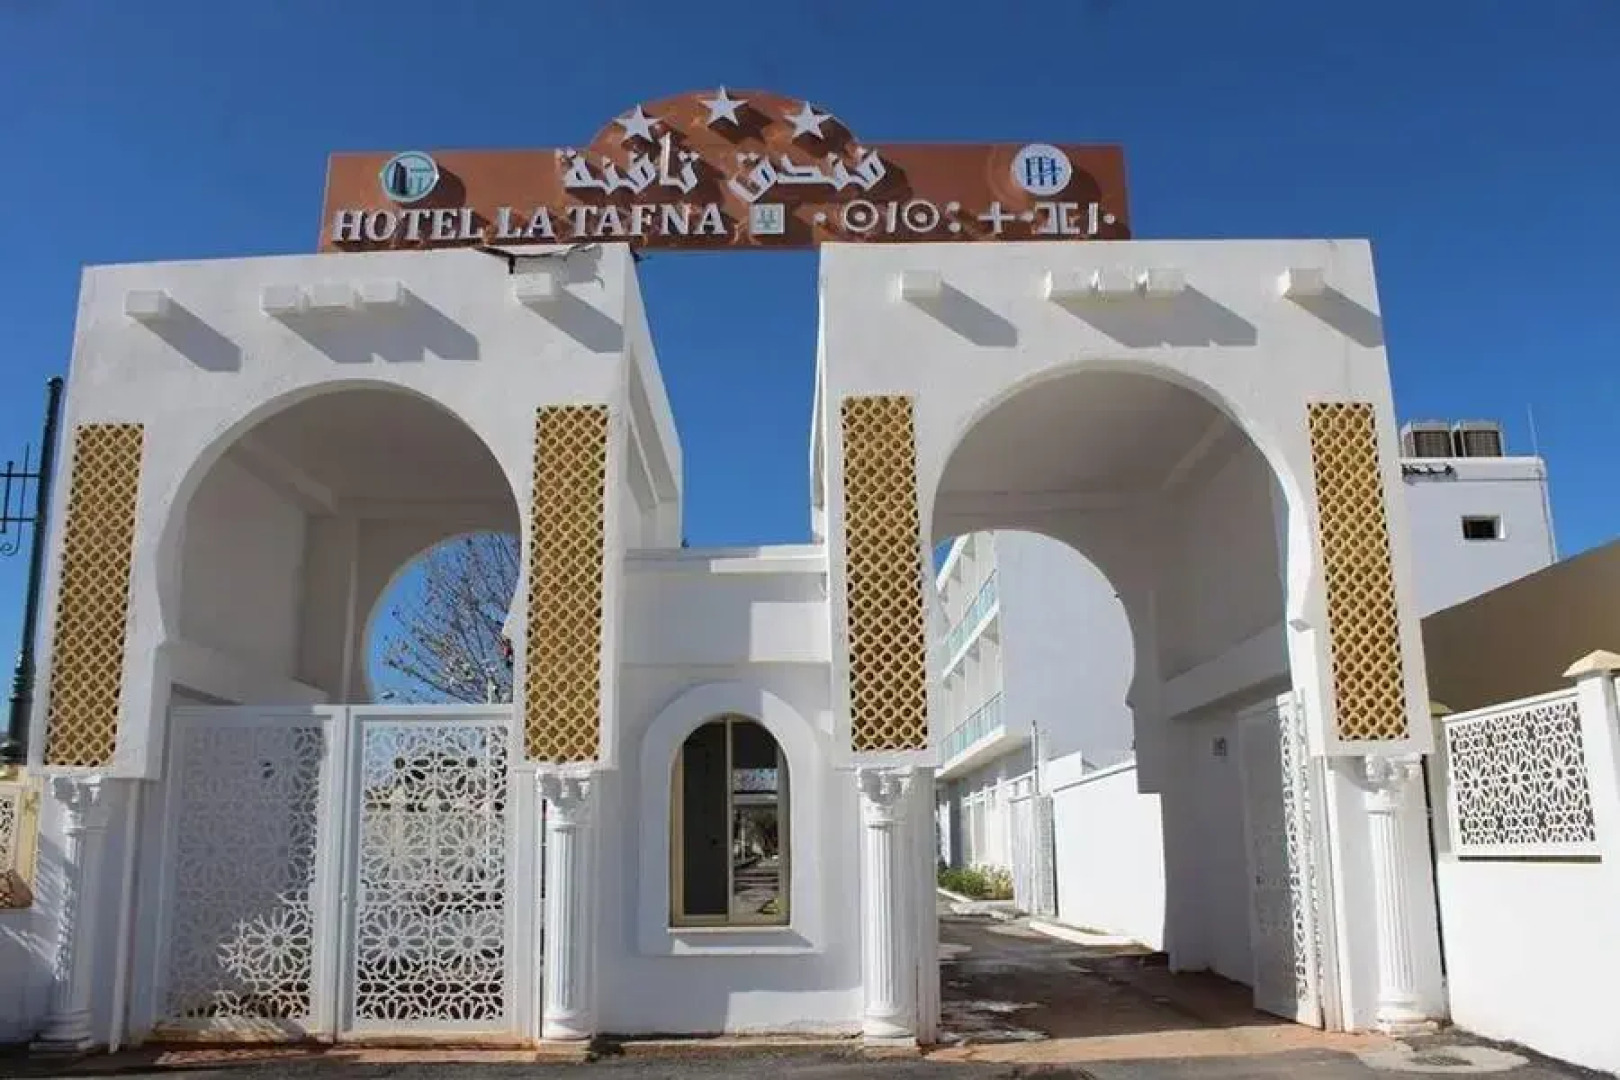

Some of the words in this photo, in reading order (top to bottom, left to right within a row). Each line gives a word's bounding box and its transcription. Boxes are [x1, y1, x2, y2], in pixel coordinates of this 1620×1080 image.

[554, 131, 700, 195] تافنة
[728, 146, 887, 201] فندق
[331, 207, 484, 242] HOTEL
[499, 206, 556, 239] LA
[567, 202, 727, 237] TAFNA
